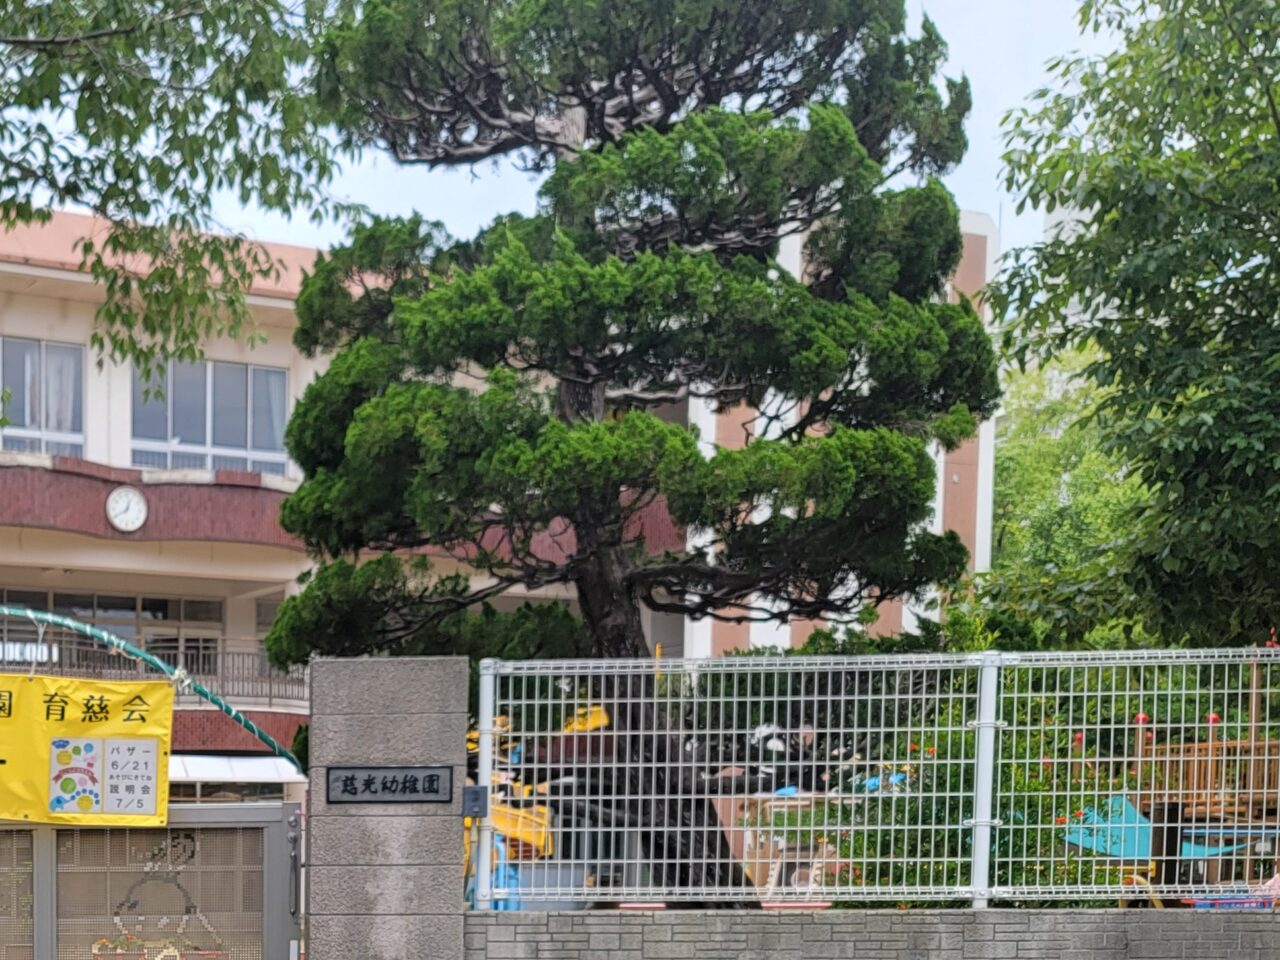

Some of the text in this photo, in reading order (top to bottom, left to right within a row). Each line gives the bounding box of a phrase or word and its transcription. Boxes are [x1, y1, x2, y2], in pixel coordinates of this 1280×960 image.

[42, 692, 152, 724] 育慈会
[110, 746, 151, 756] バザー
[109, 784, 151, 795] 説明会
[341, 773, 440, 796] 慈光幼稚園
